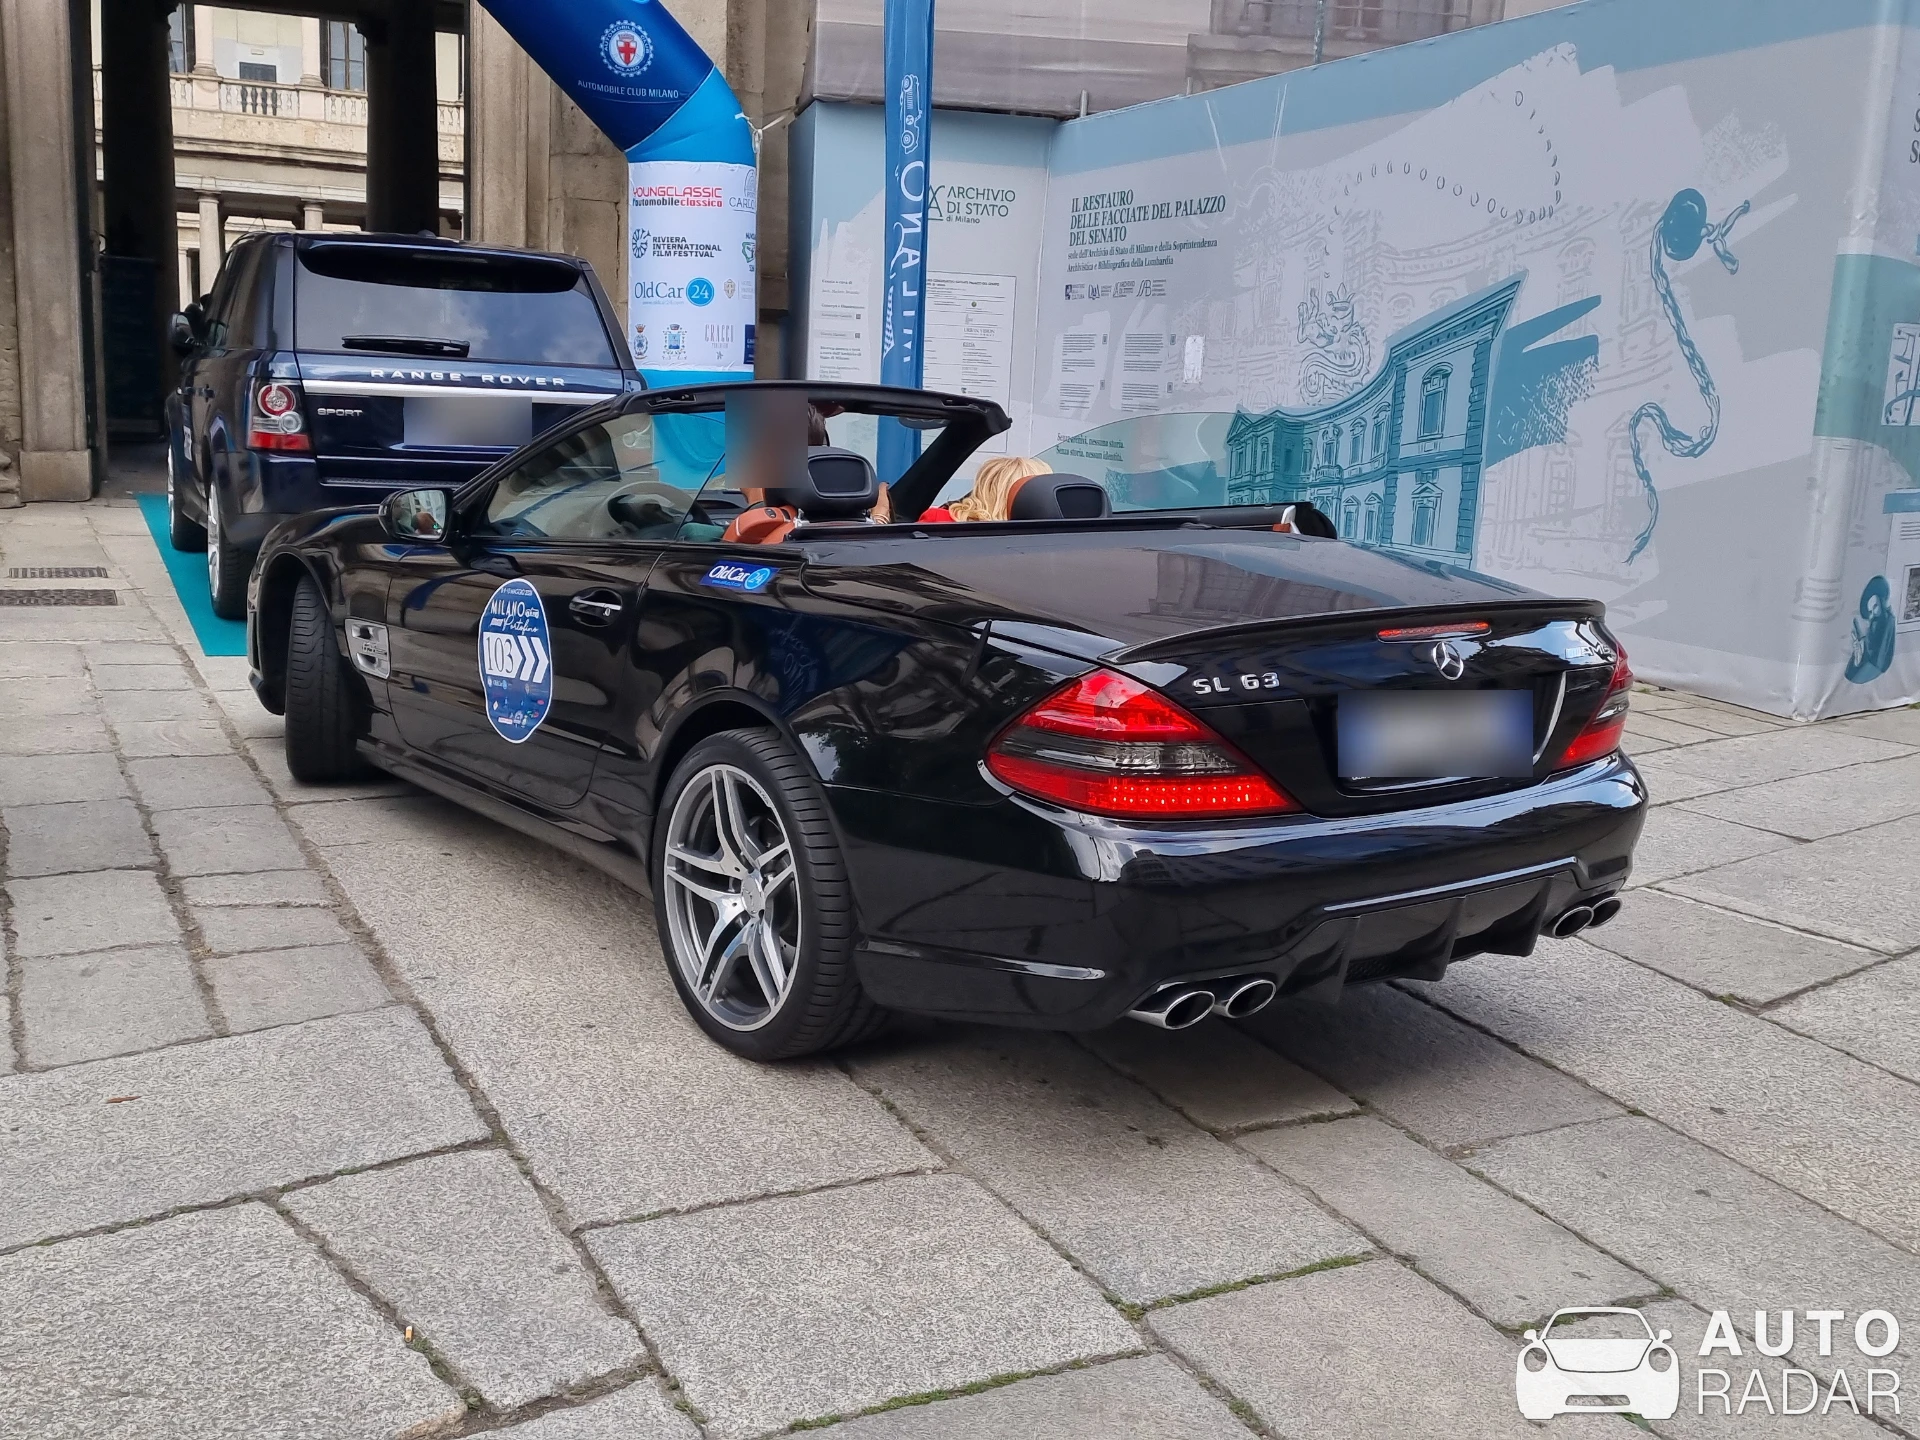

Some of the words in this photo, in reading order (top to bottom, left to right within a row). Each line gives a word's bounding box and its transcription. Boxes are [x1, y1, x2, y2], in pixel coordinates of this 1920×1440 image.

[577, 79, 625, 95] AUTOMOBILE
[626, 87, 647, 97] CLUB
[648, 89, 679, 99] MILANO
[946, 185, 1016, 203] ARCHIVIO
[1071, 197, 1081, 213] IL
[1082, 189, 1134, 211] RESTAURO
[946, 201, 961, 214] DI
[965, 202, 1009, 217] STATO
[1070, 211, 1100, 230] DELLE
[1101, 204, 1150, 226] FACCIATE
[1151, 203, 1173, 220] DEL
[1174, 194, 1226, 216] PALAZZO
[955, 215, 981, 224] Milano
[1069, 230, 1088, 247] DEL
[1088, 225, 1127, 245] SENATO
[652, 243, 722, 252] INTERNATIONAL
[673, 250, 715, 258] FESTIVAL
[1115, 246, 1129, 255] Stato
[1136, 243, 1153, 253] Milano
[1158, 241, 1171, 252] della
[1172, 237, 1218, 252] Soprintendenza
[1130, 257, 1144, 267] della
[1144, 254, 1174, 266] Lombardia
[634, 281, 684, 299] OldCar
[691, 284, 709, 299] 24
[370, 368, 463, 382] RANGE
[481, 374, 566, 387] ROVER
[316, 407, 363, 418] SPORT
[708, 565, 750, 582] OldCar
[748, 571, 766, 584] 24
[490, 599, 525, 618] MILANO
[502, 615, 538, 637] Portofino
[485, 635, 514, 674] 103
[1192, 677, 1231, 694] SL
[1240, 672, 1280, 691] 63
